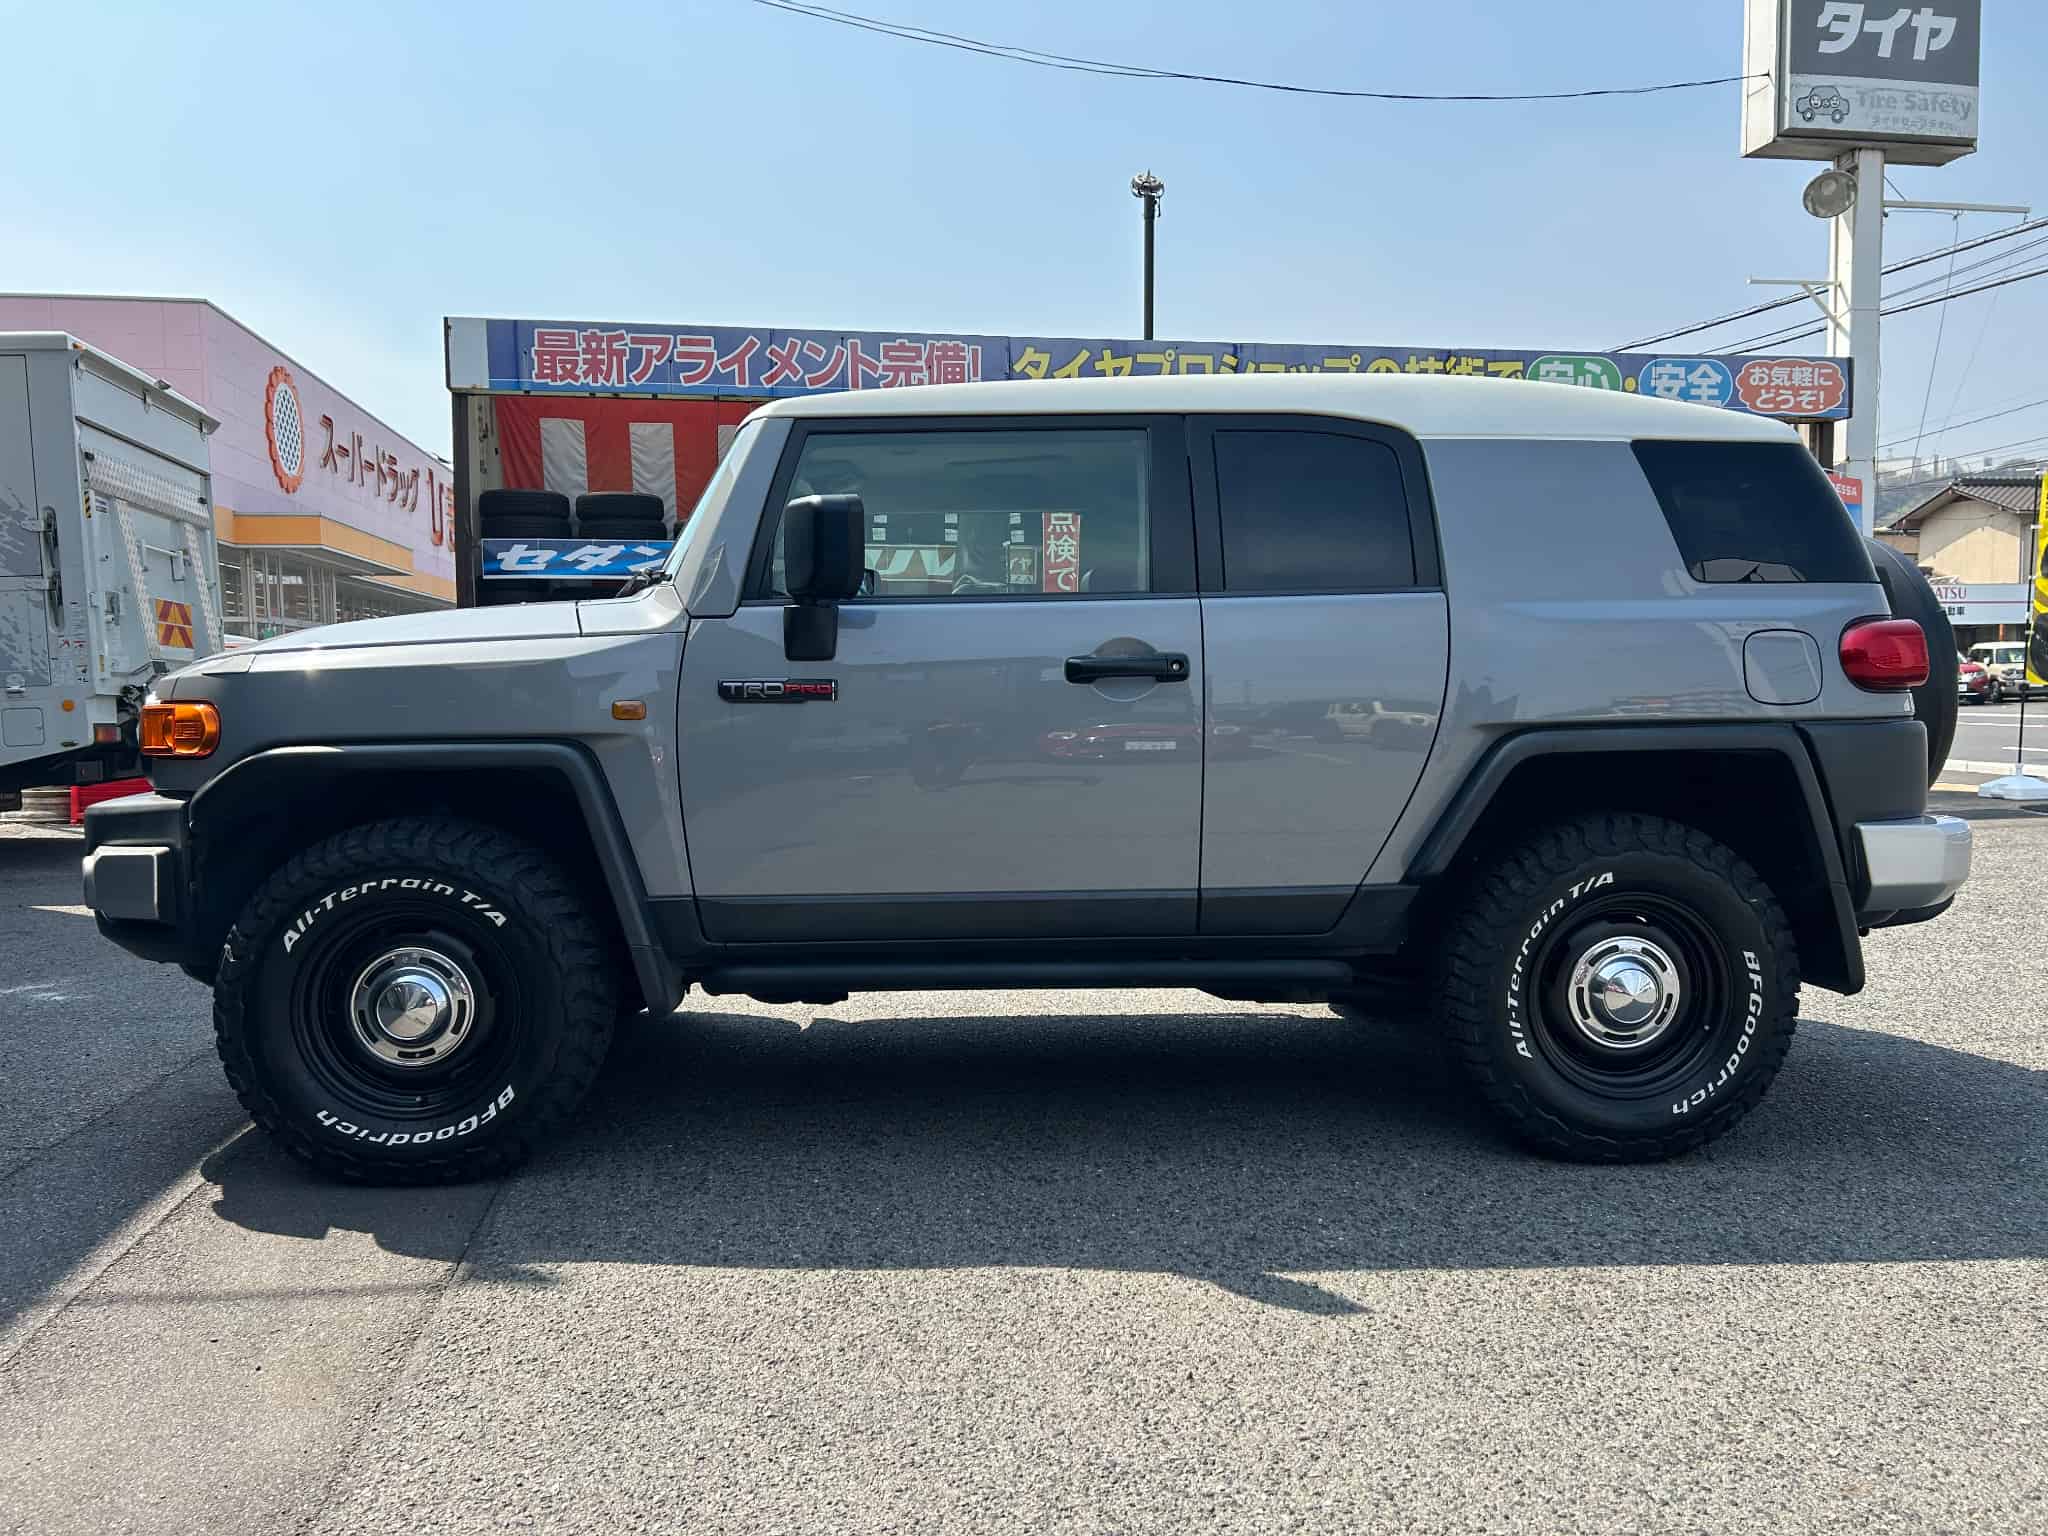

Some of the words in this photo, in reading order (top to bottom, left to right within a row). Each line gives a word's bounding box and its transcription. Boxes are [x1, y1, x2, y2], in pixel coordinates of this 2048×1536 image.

[1816, 1, 1957, 61] タイヤ
[1903, 93, 1972, 121] Safety
[1749, 366, 1833, 386] お気軽に
[1755, 389, 1825, 409] どうぞ!
[320, 413, 420, 513] スーパードラッグ
[497, 544, 667, 573] セダン
[1046, 512, 1077, 591] 点検で
[722, 682, 784, 699] TRD
[282, 877, 455, 953] All-Terrain
[460, 889, 509, 928] T/A
[1506, 897, 1565, 1059] All-Terrain
[1567, 871, 1615, 900] T/A
[1671, 950, 1763, 1115] BFGoodrich
[315, 1085, 516, 1147] BFGoodrich
